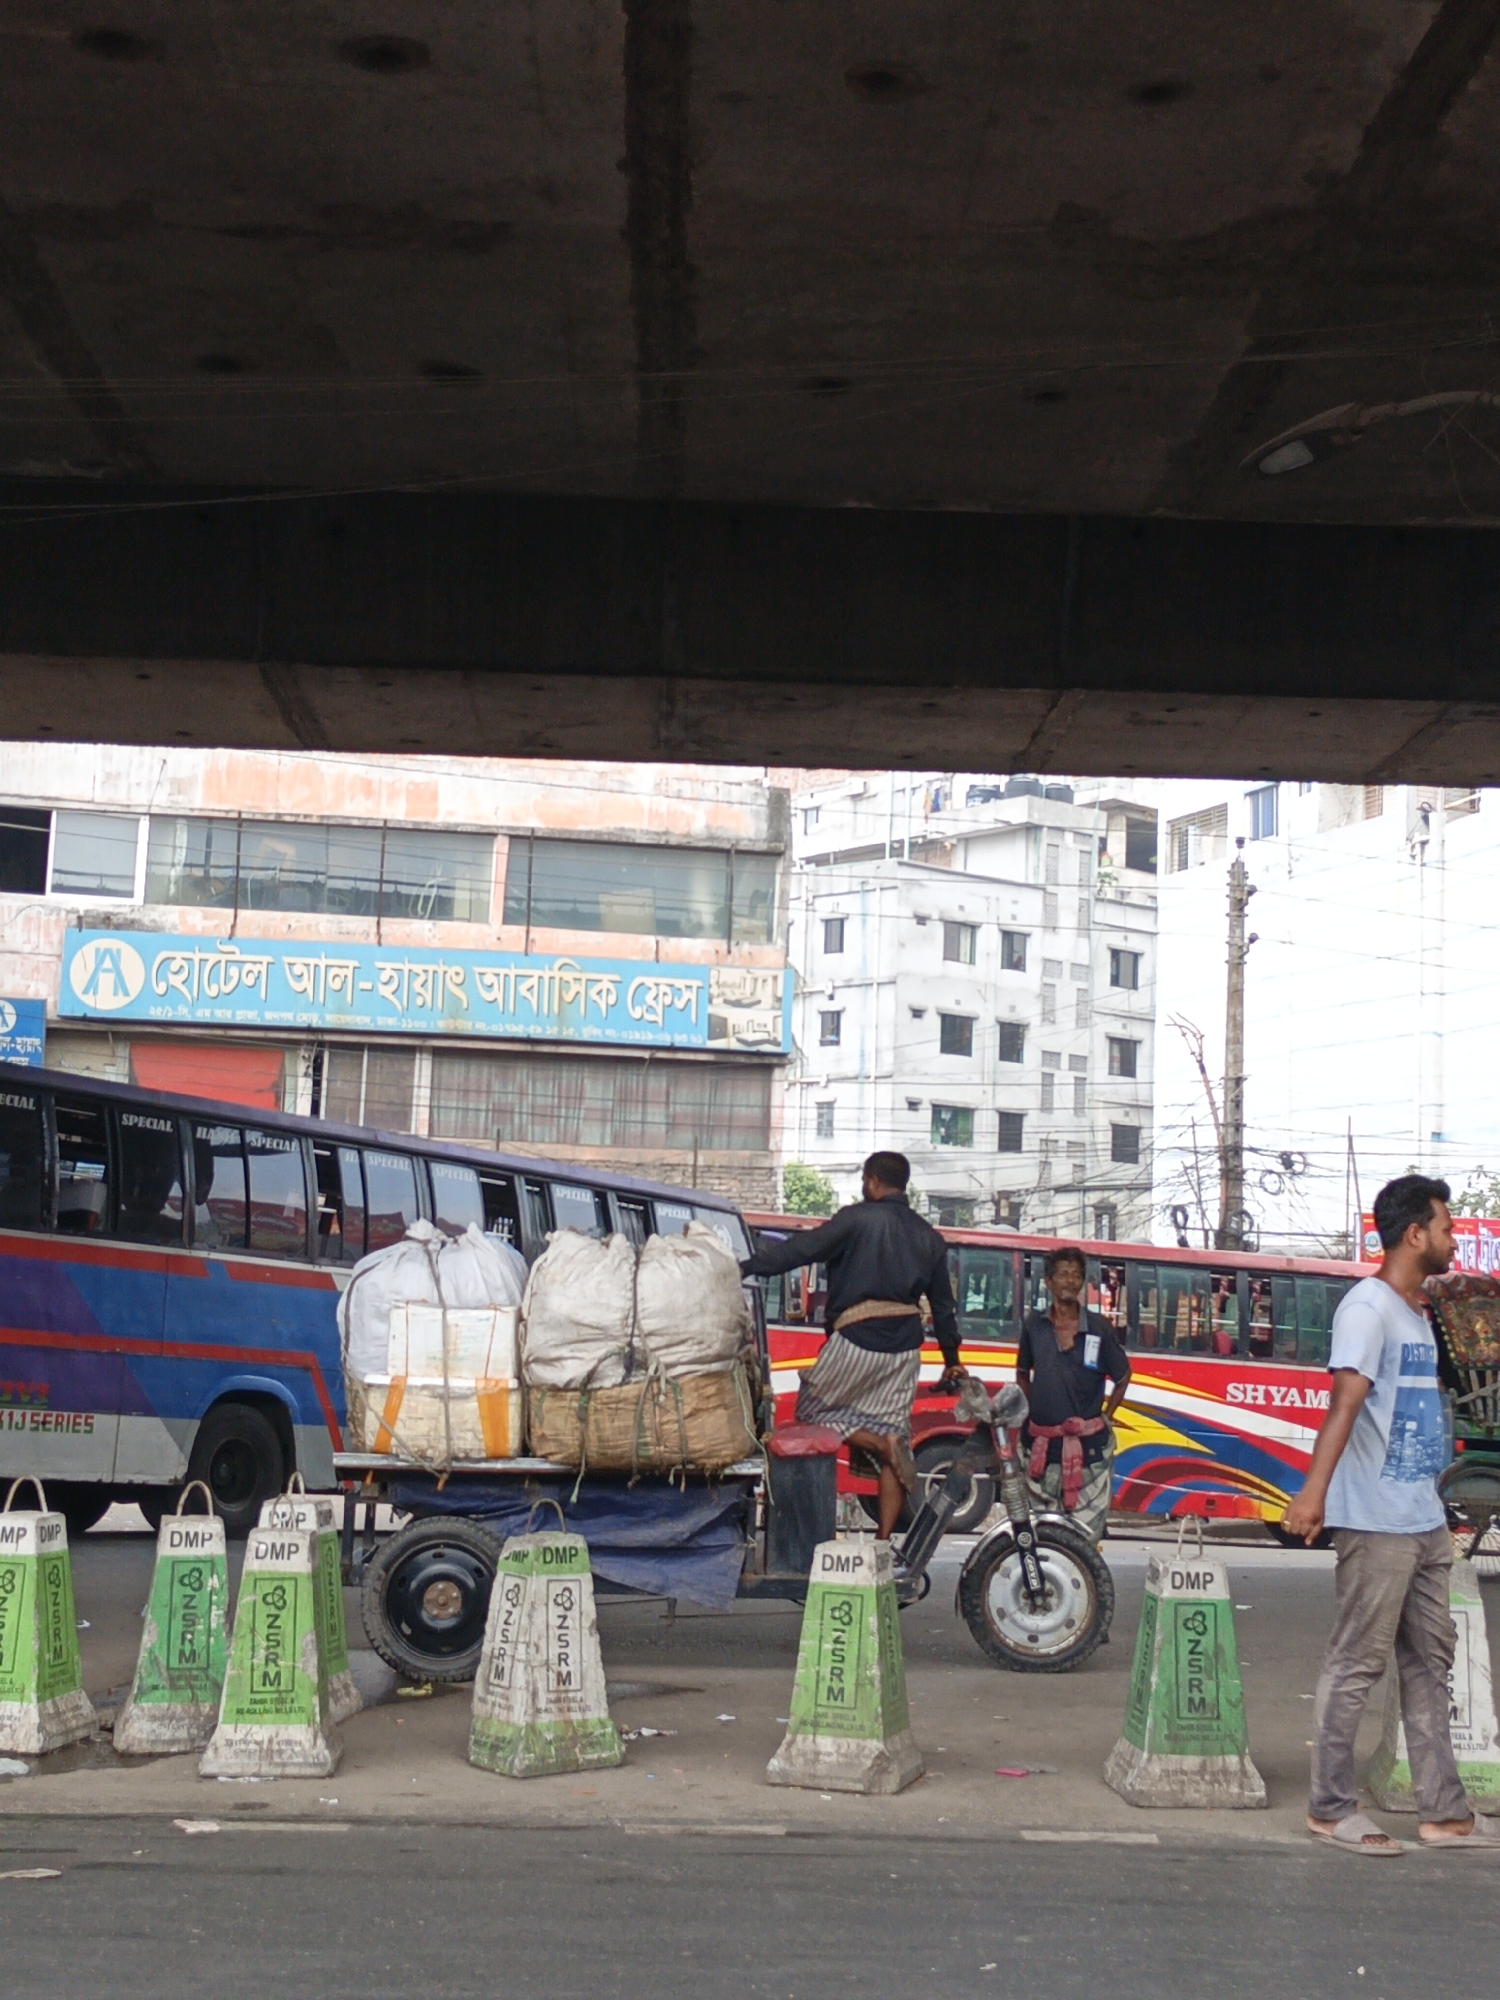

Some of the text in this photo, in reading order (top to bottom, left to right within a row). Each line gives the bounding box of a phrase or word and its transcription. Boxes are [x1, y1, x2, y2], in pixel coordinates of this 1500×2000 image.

[152, 940, 274, 1003] হোটেল
[473, 958, 623, 1019] আবাসিক
[0, 1093, 36, 1110] ECIAL
[122, 1113, 173, 1132] SPECIAL
[251, 1137, 298, 1152] SPECIAL
[368, 1155, 410, 1171] SPECIAL
[435, 1167, 473, 1182] SPECIAL
[555, 1187, 591, 1203] SPECIAL
[657, 1207, 691, 1220] SPECIAL
[1226, 1383, 1331, 1409] SHYAM
[30, 1412, 94, 1434] SERIES
[0, 1527, 27, 1544] MP
[40, 1523, 61, 1543] DMP
[169, 1531, 213, 1548] DMP
[255, 1542, 299, 1561] DMP
[543, 1546, 579, 1564] DMP
[821, 1554, 864, 1573] DMP
[1171, 1571, 1214, 1590] DMP
[51, 1592, 63, 1660] ZSRM
[178, 1595, 197, 1664] ZSRM
[262, 1614, 281, 1687] ZSRM
[494, 1610, 513, 1682] ZSRM
[557, 1615, 572, 1686] ZSRM
[1187, 1639, 1206, 1713] ZSRM
